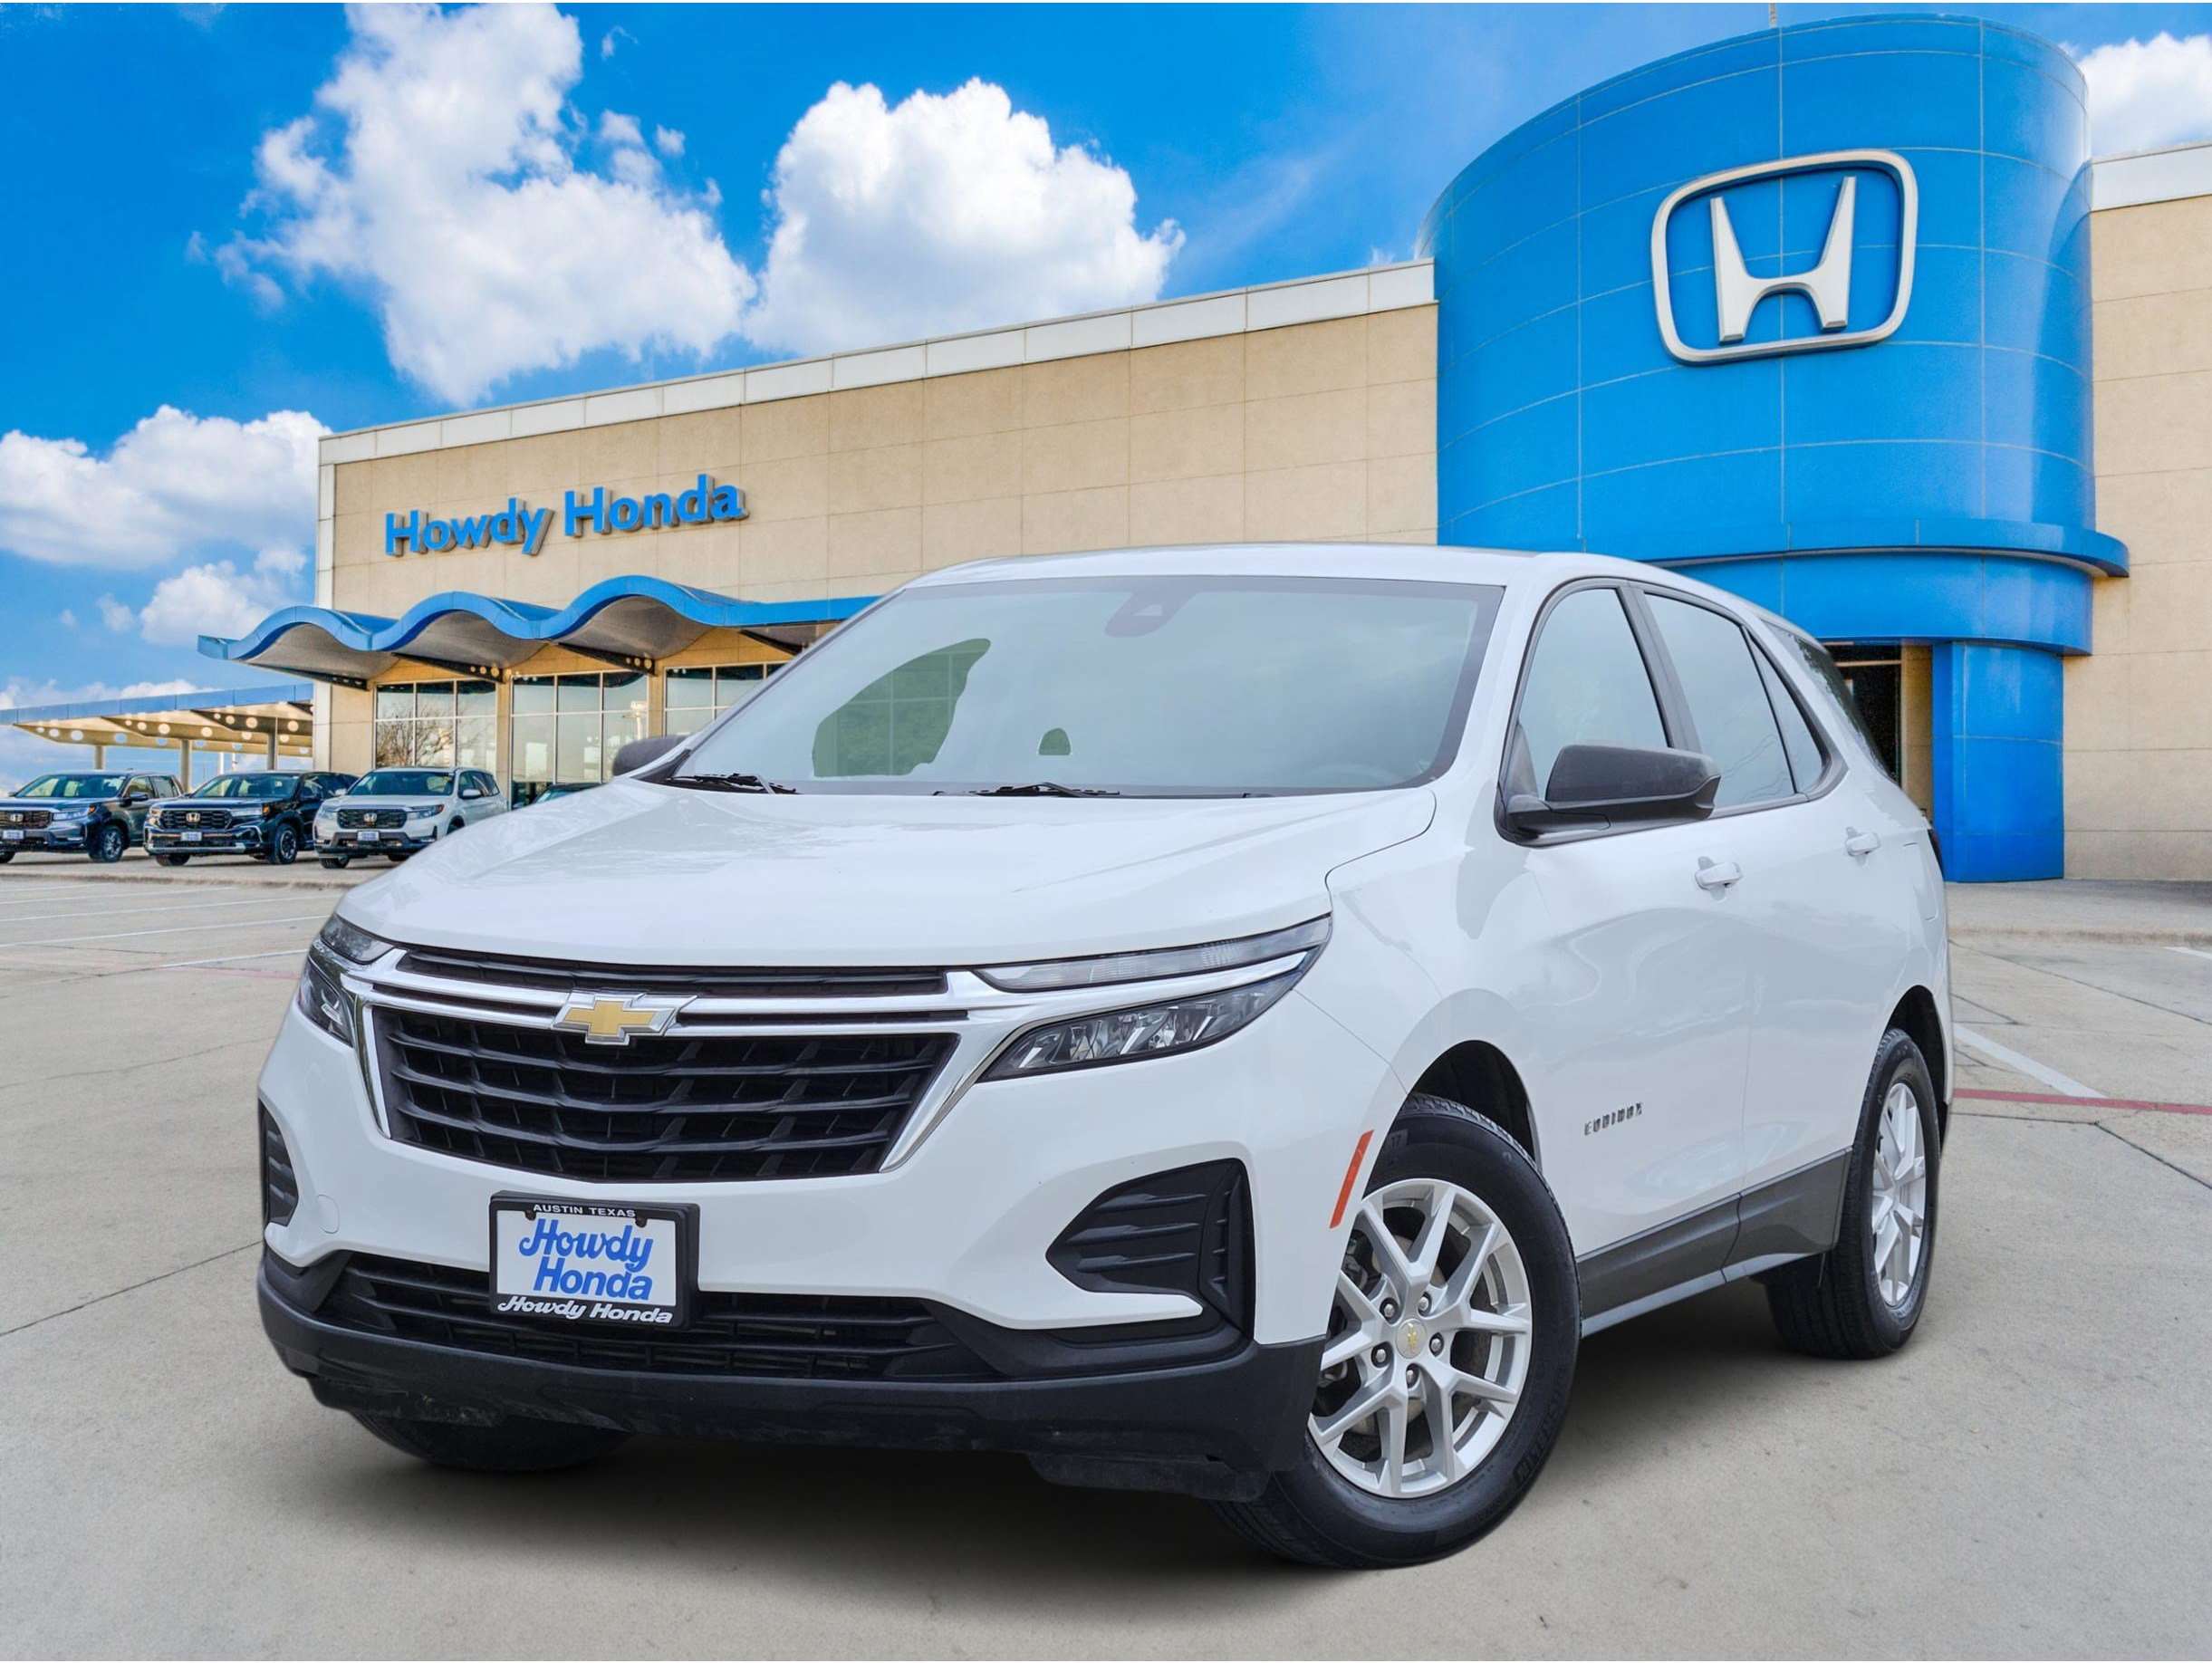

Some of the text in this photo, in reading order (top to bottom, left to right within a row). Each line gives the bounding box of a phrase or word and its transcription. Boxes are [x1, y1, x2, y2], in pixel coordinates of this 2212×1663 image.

[385, 474, 749, 556] Howdy Honda
[533, 1204, 636, 1218] AUSTIN TEXAS
[519, 1218, 654, 1272] Howdy
[533, 1255, 653, 1301] Honda
[497, 1295, 673, 1324] Howdy Honda
